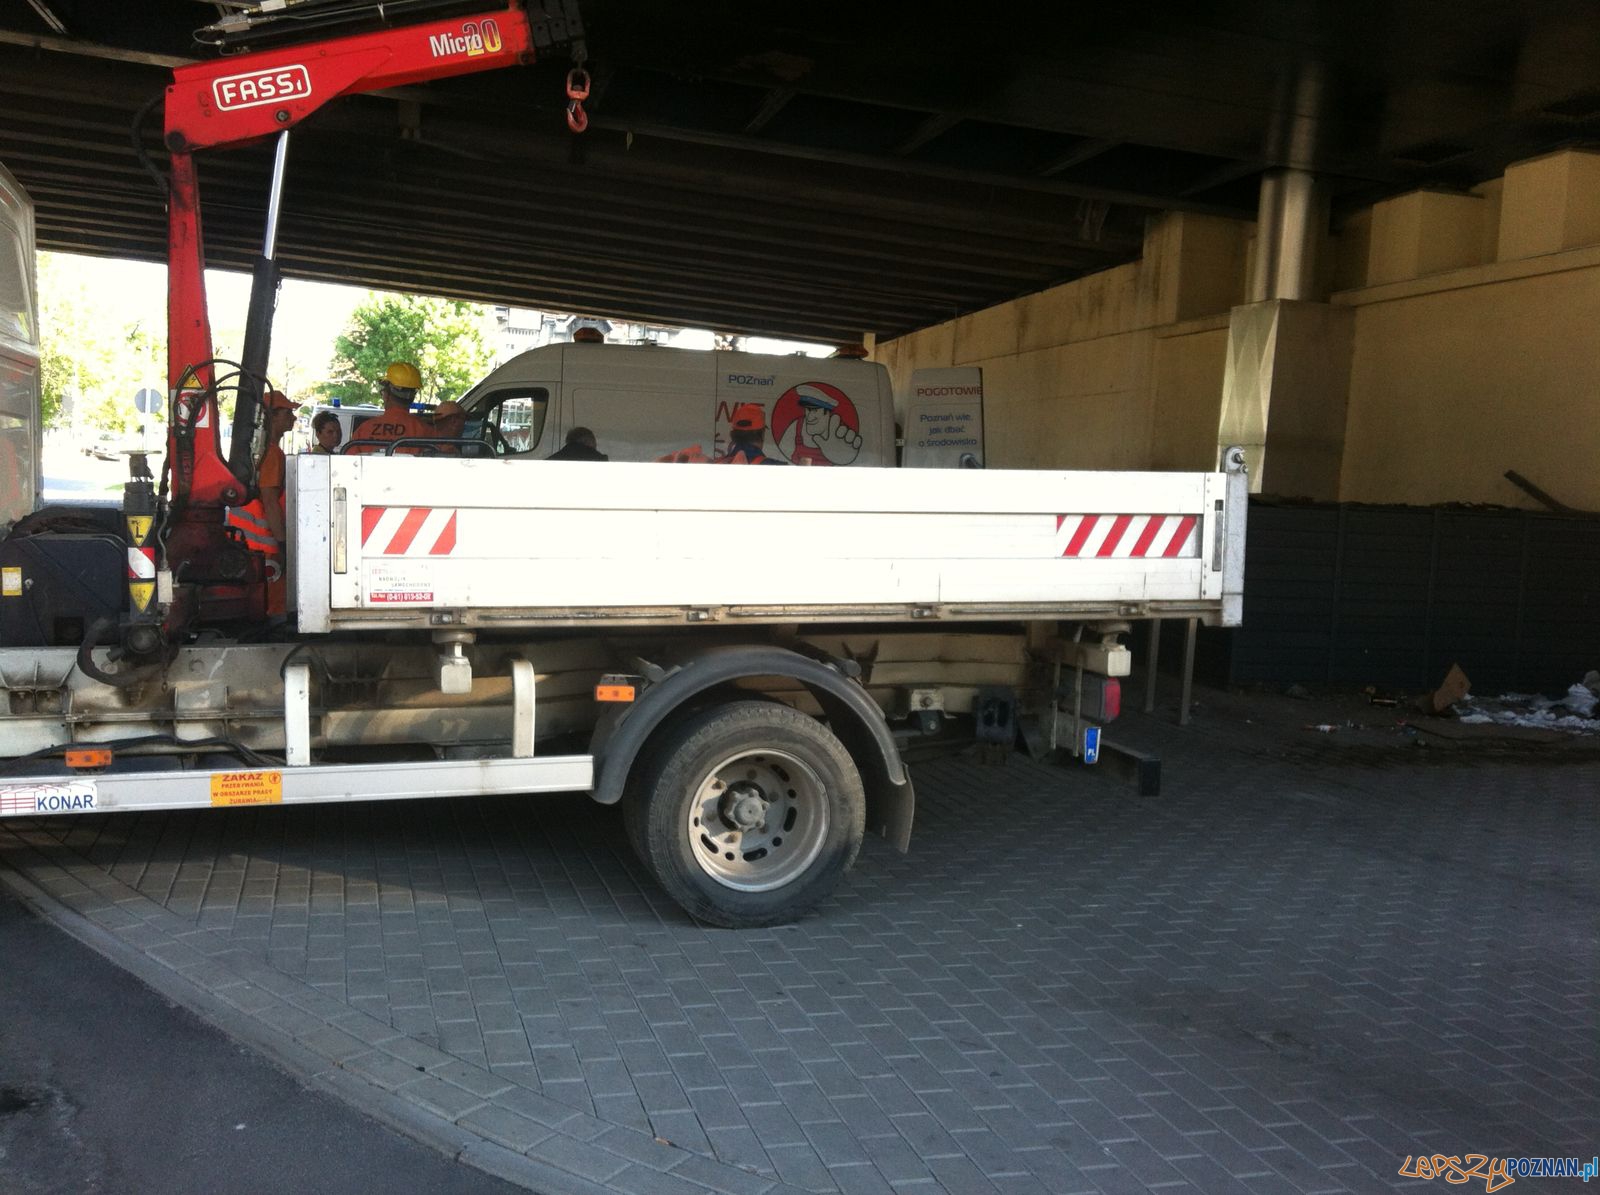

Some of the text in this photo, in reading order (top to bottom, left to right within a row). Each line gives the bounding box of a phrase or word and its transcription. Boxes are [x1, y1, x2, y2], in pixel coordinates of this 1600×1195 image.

[429, 18, 502, 58] Micro 20
[920, 413, 954, 422] Poznań
[370, 423, 406, 436] ZRD
[928, 426, 943, 436] jak
[926, 437, 977, 447] środowisko
[222, 773, 263, 782] ZAKAZ
[37, 794, 93, 811] KONAR
